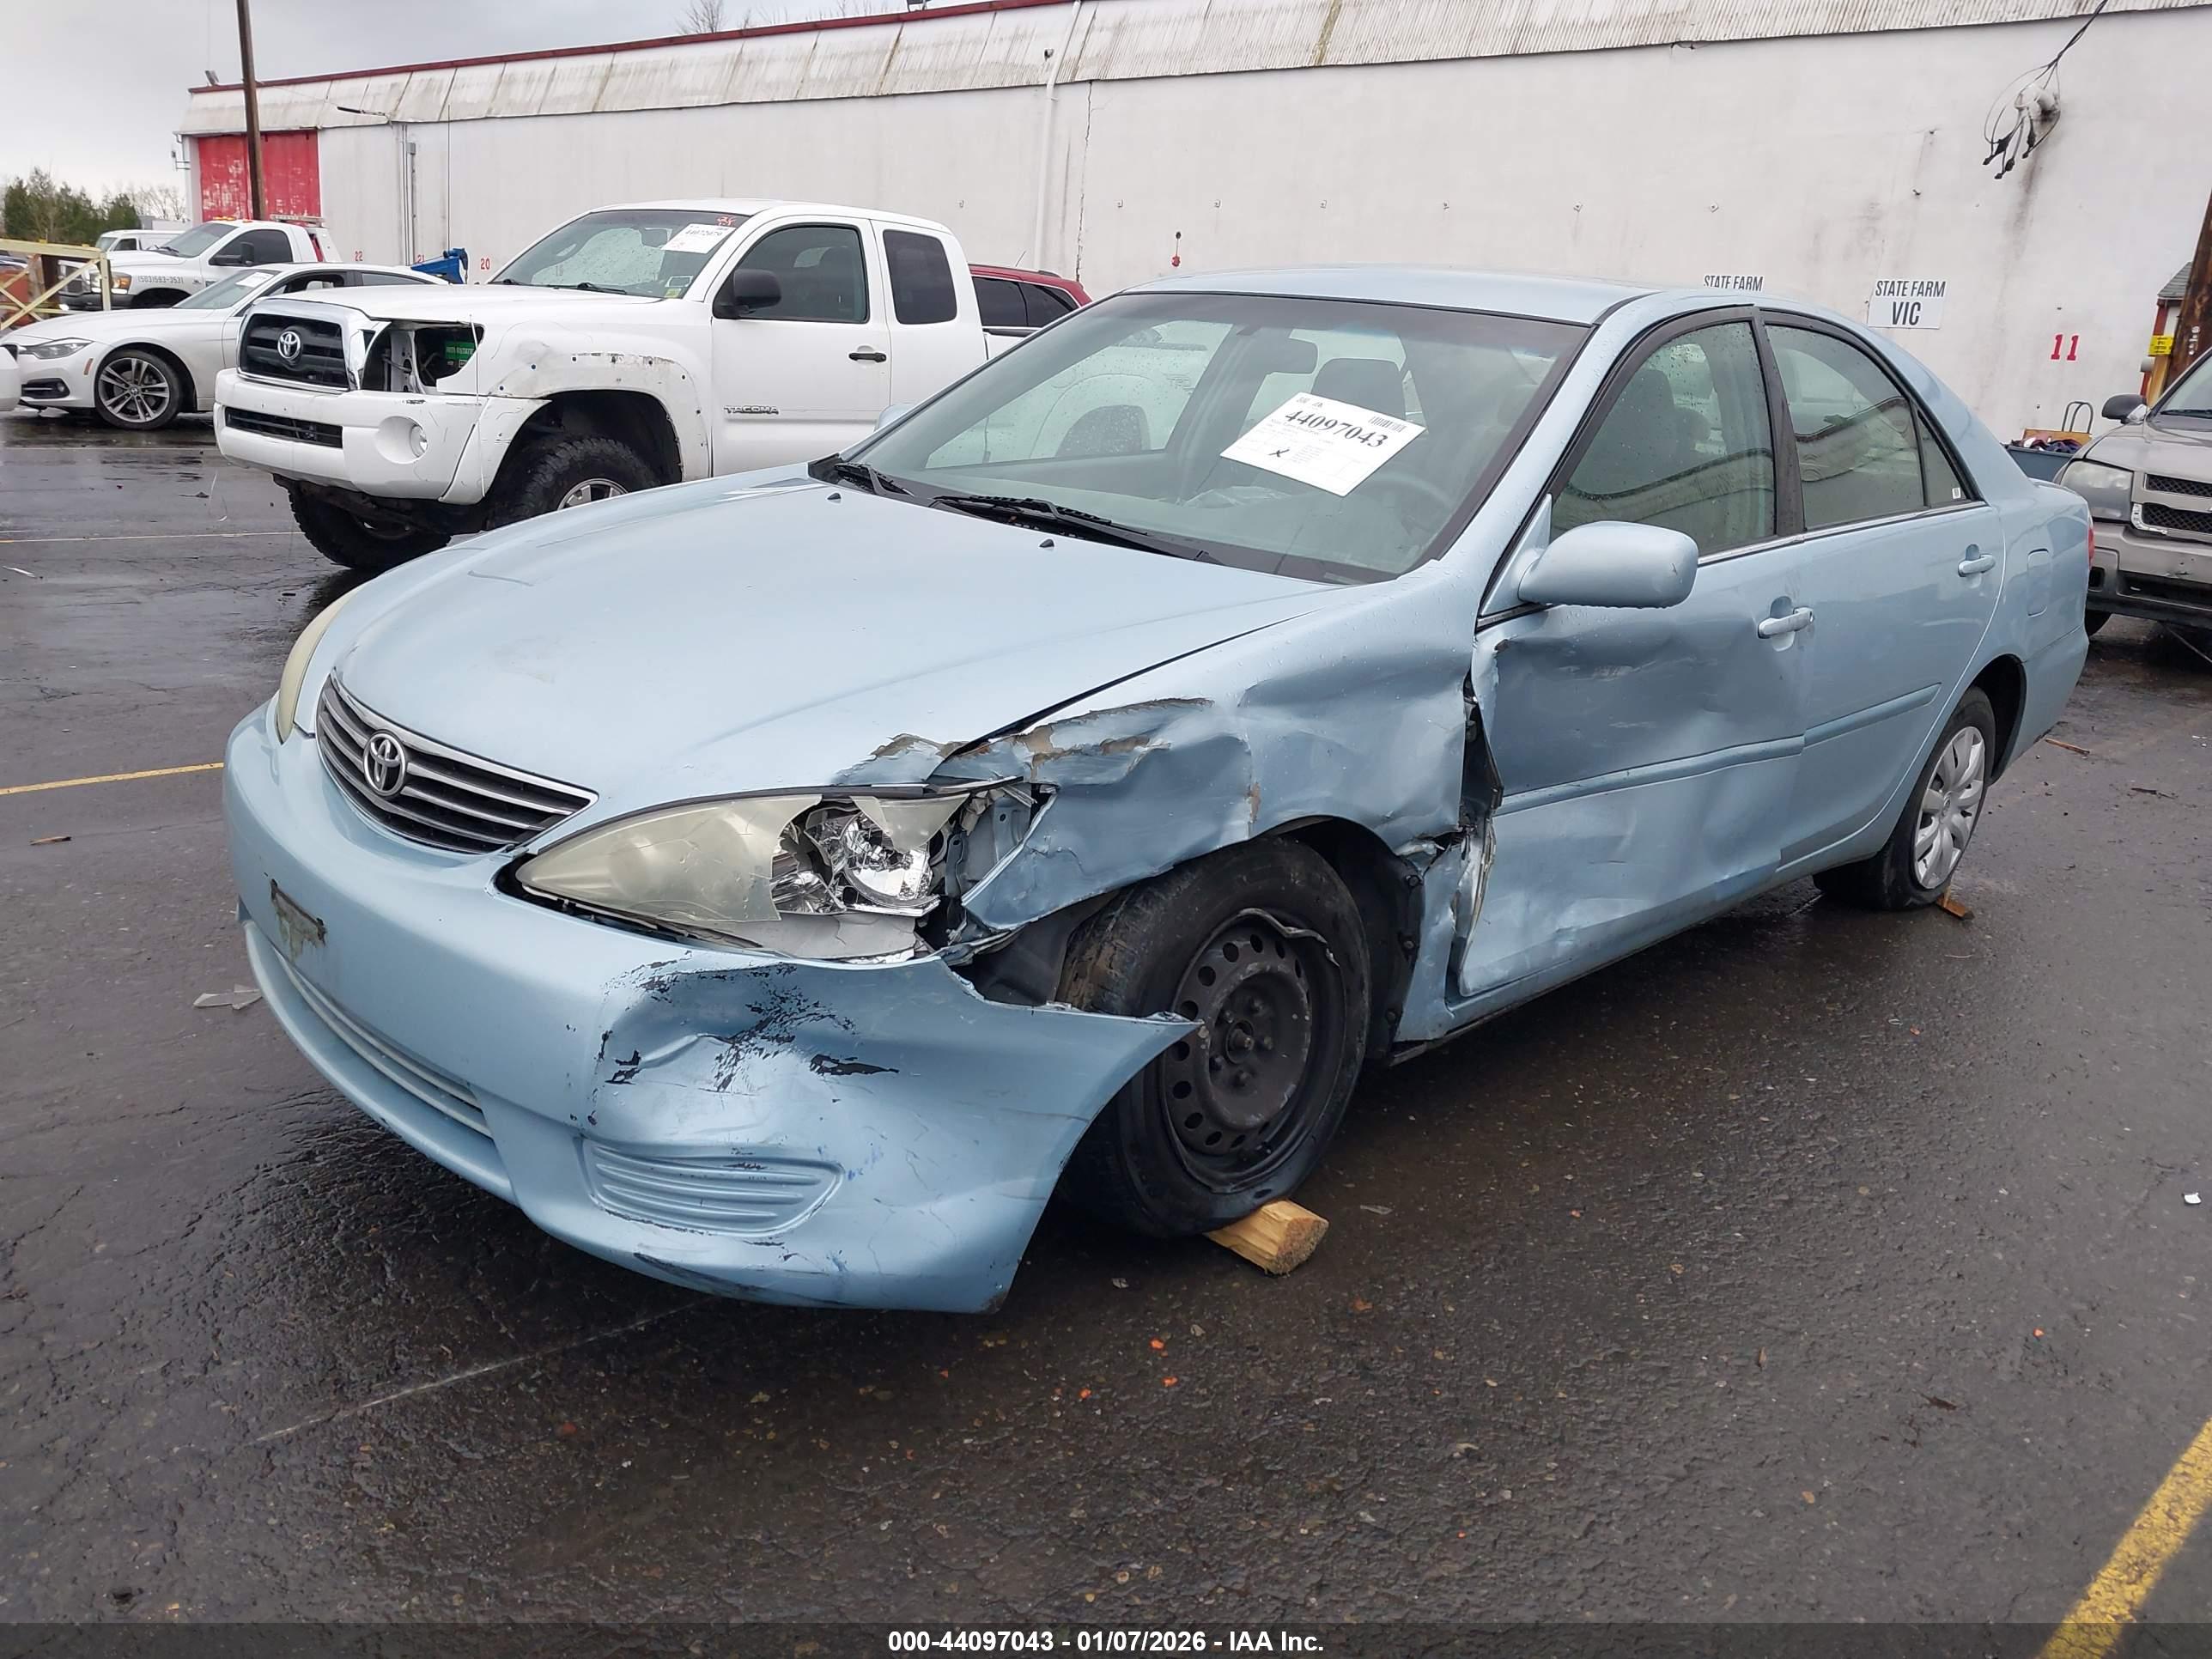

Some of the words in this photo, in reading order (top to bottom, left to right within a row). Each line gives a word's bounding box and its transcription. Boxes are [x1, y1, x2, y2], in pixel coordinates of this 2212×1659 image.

[355, 251, 363, 262] 22
[480, 258, 490, 270] 20
[1704, 275, 1731, 289] STATE
[1733, 276, 1764, 292] FARM
[1875, 280, 1910, 297] STATE
[1911, 281, 1947, 298] FARM
[1892, 301, 1922, 325] VIC
[2050, 333, 2080, 362] 11
[1285, 410, 1389, 447] 44097043
